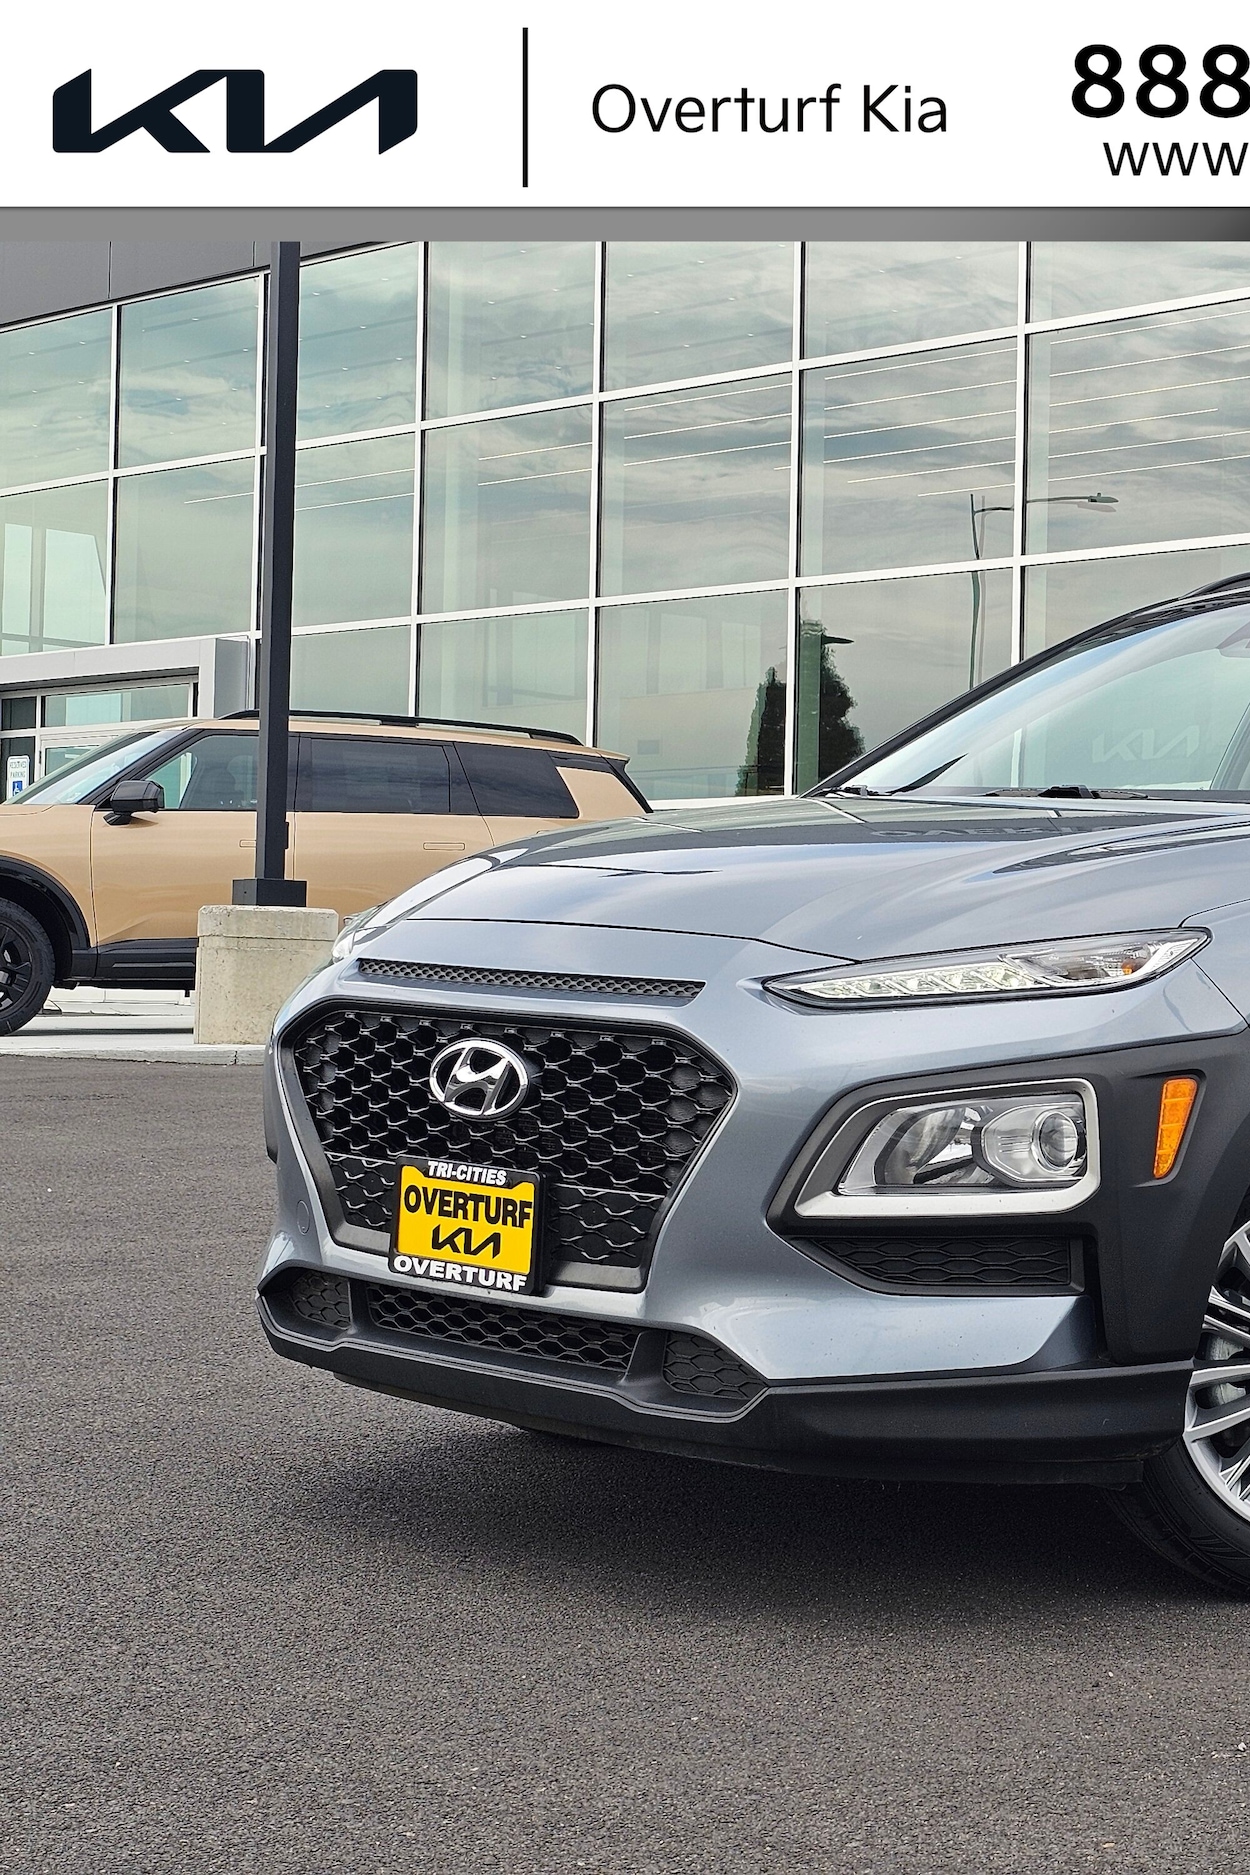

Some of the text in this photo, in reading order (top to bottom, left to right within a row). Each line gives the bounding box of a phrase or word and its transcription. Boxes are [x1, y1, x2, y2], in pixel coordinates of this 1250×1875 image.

[1092, 724, 1201, 764] KIA
[428, 1160, 507, 1186] TRI-CITIES
[404, 1184, 533, 1229] OVERTURF
[431, 1224, 502, 1260] KIA
[393, 1256, 528, 1292] OVERTURF
